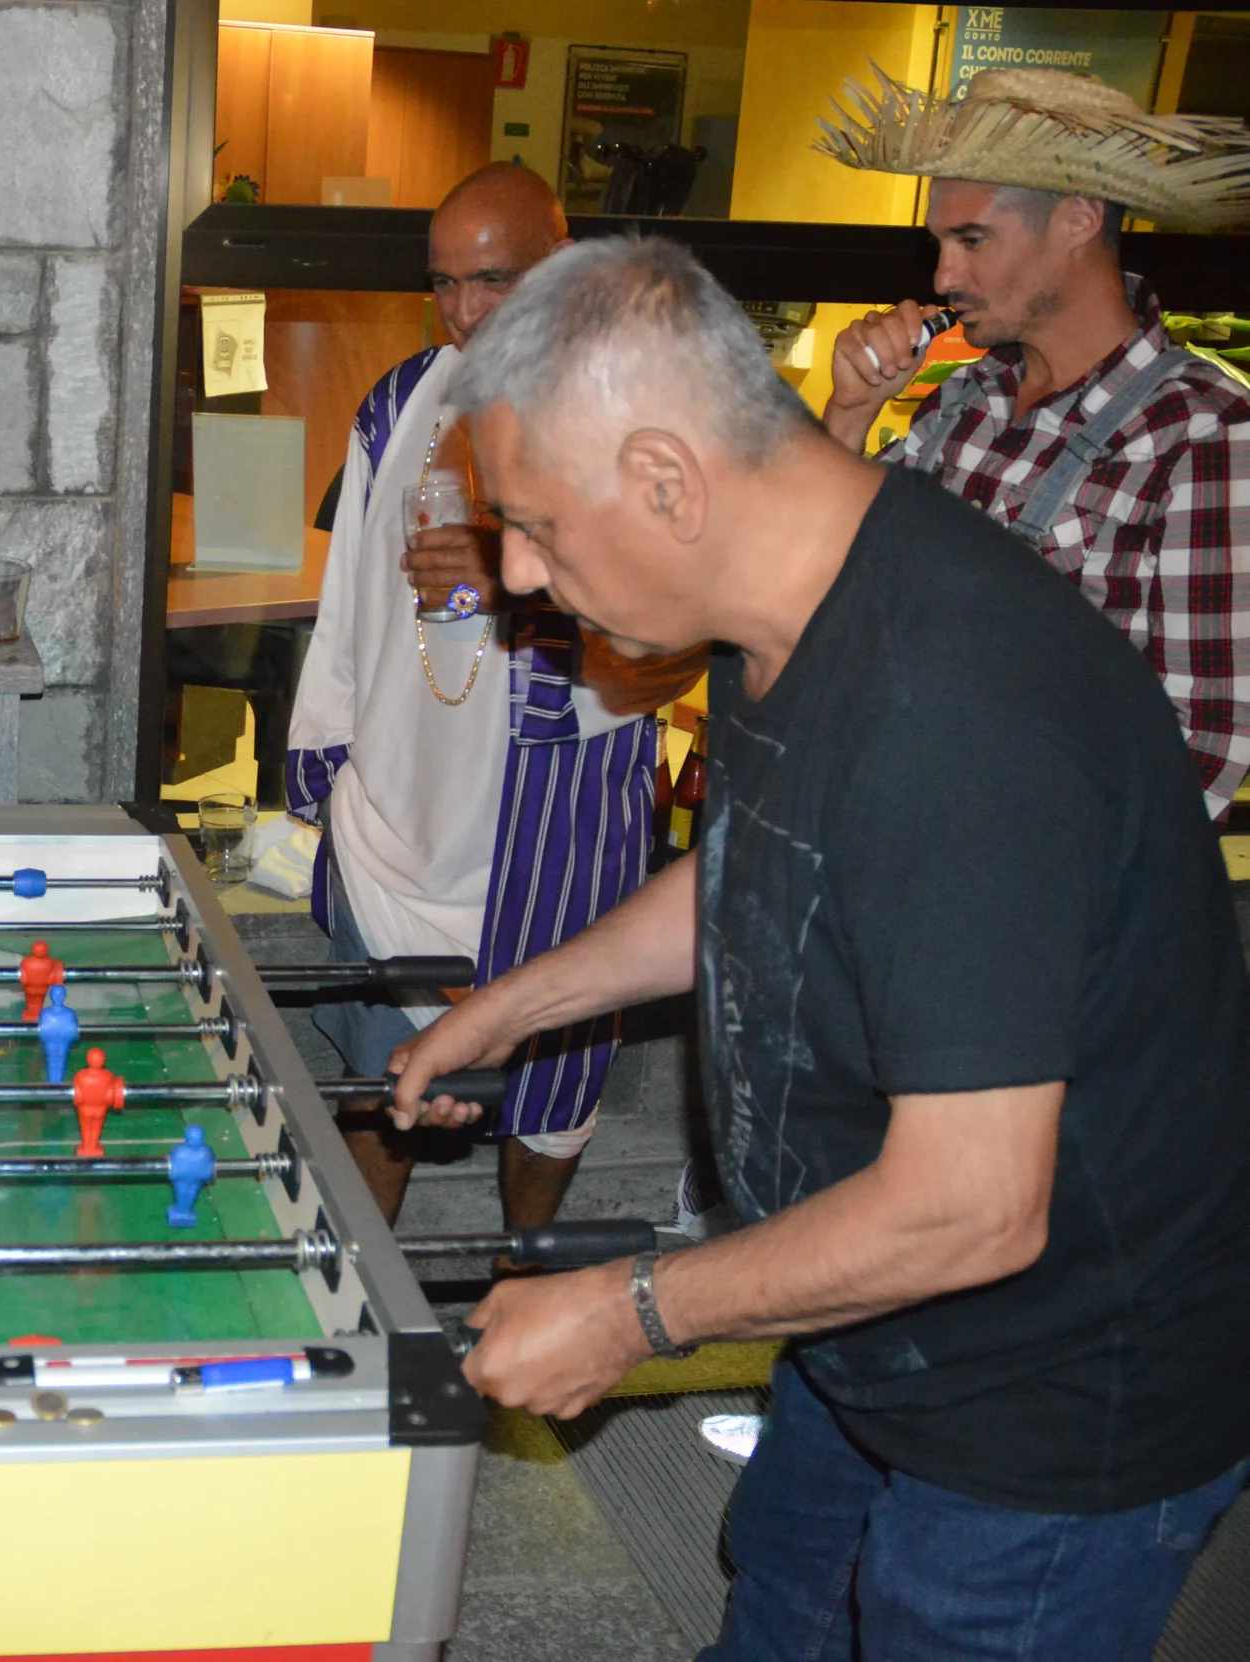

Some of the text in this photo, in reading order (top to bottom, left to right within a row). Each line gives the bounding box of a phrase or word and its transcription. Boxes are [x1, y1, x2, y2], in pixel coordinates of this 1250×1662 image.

[964, 31, 1001, 42] CONTO
[961, 44, 1093, 67] IL CONTO CORRENTE
